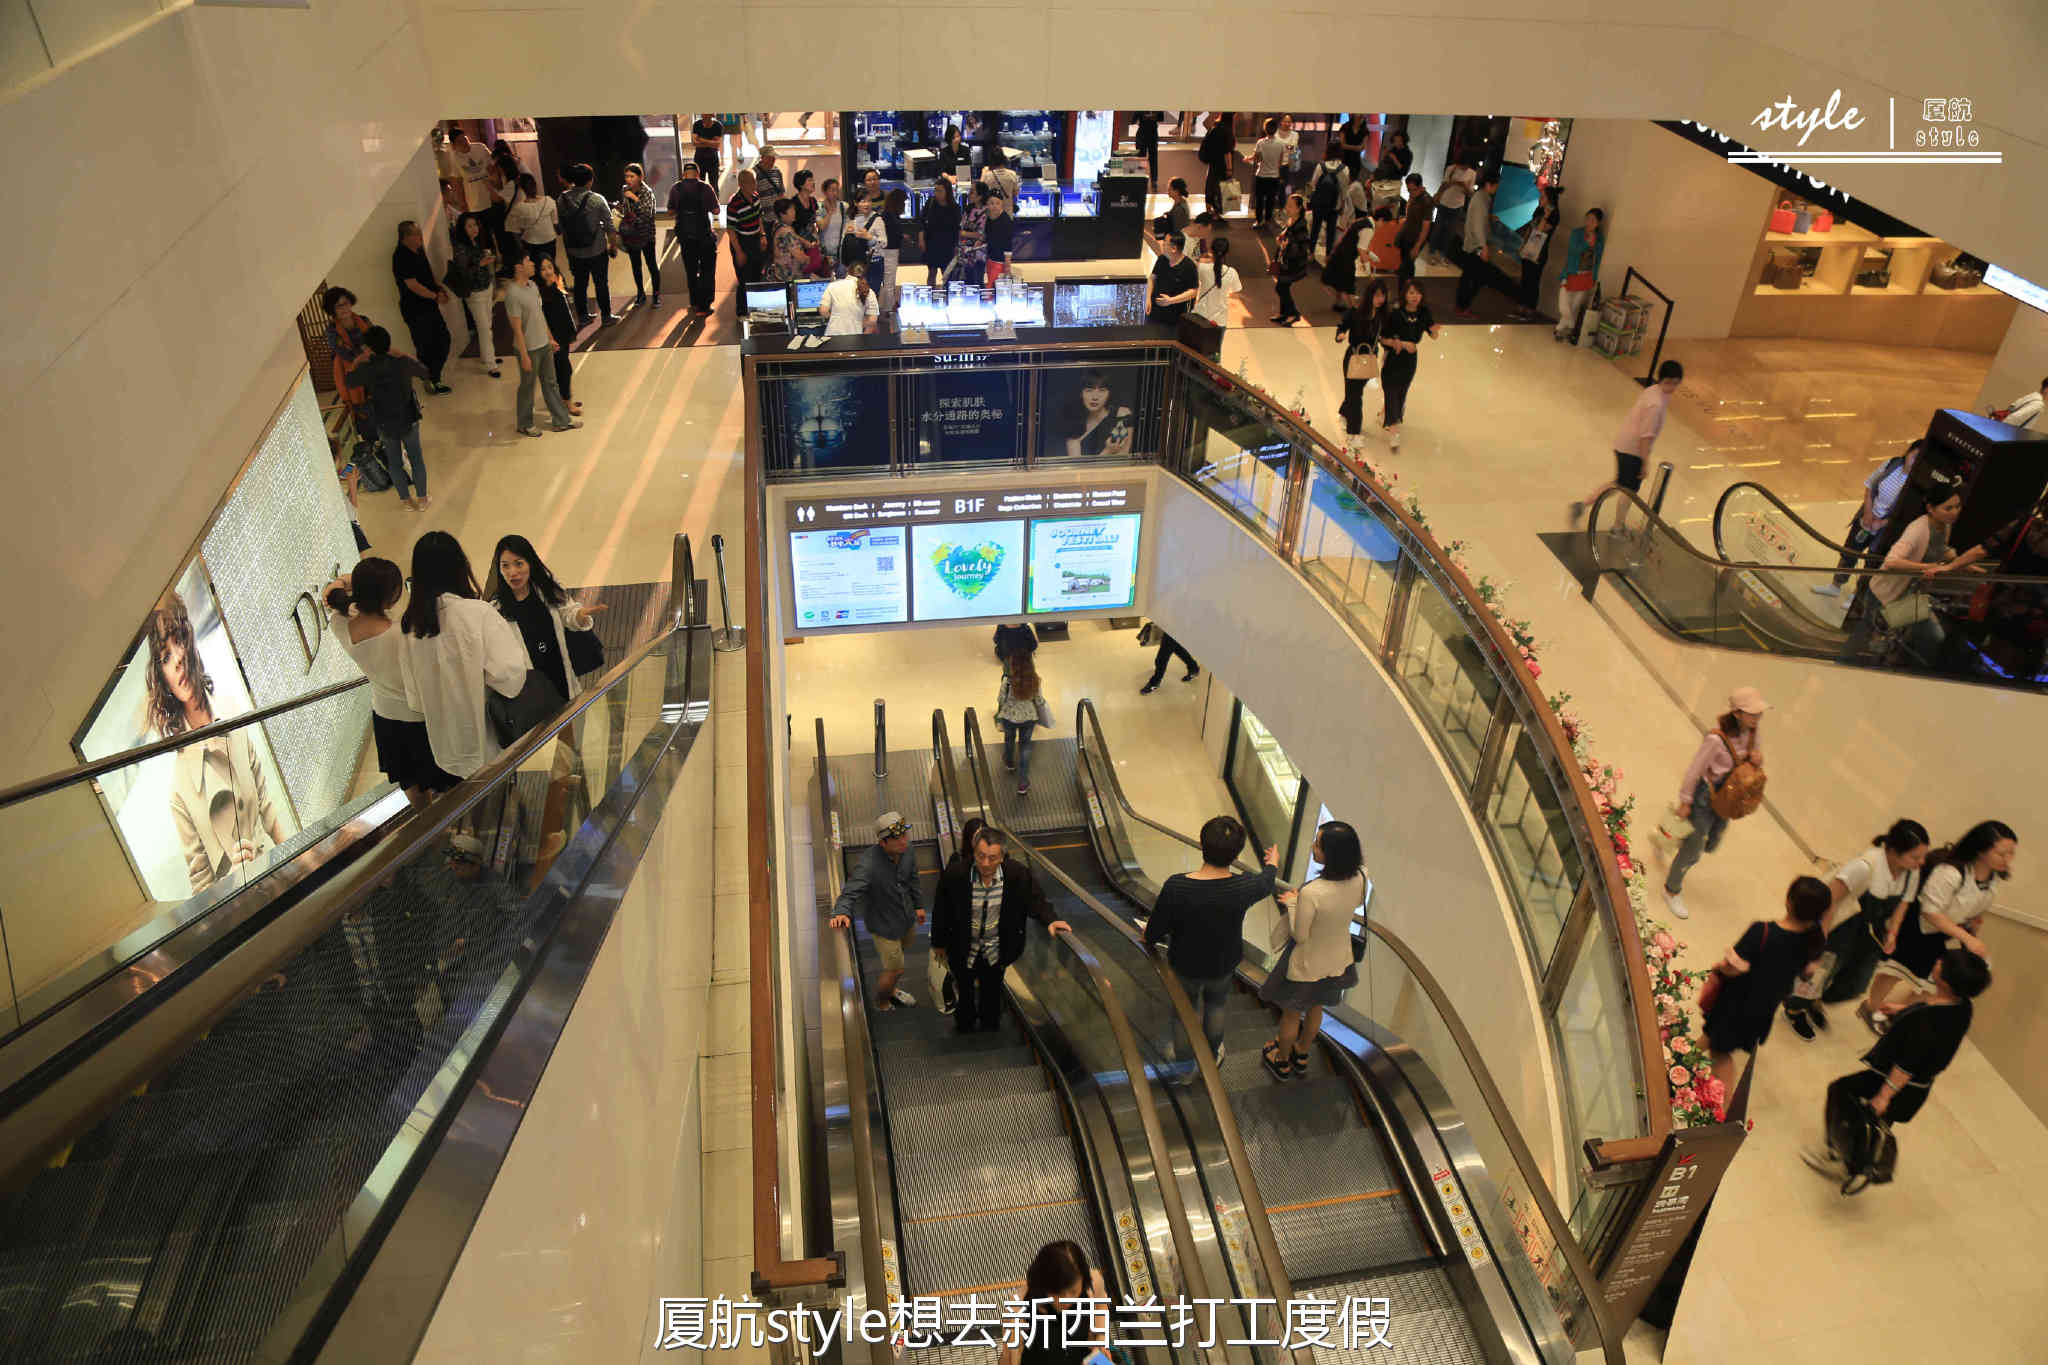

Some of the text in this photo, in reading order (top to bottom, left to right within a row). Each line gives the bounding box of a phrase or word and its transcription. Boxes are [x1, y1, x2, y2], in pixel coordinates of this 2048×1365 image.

[954, 498, 985, 514] B1F
[943, 558, 992, 575] Lovely
[1669, 1165, 1698, 1182] B1
